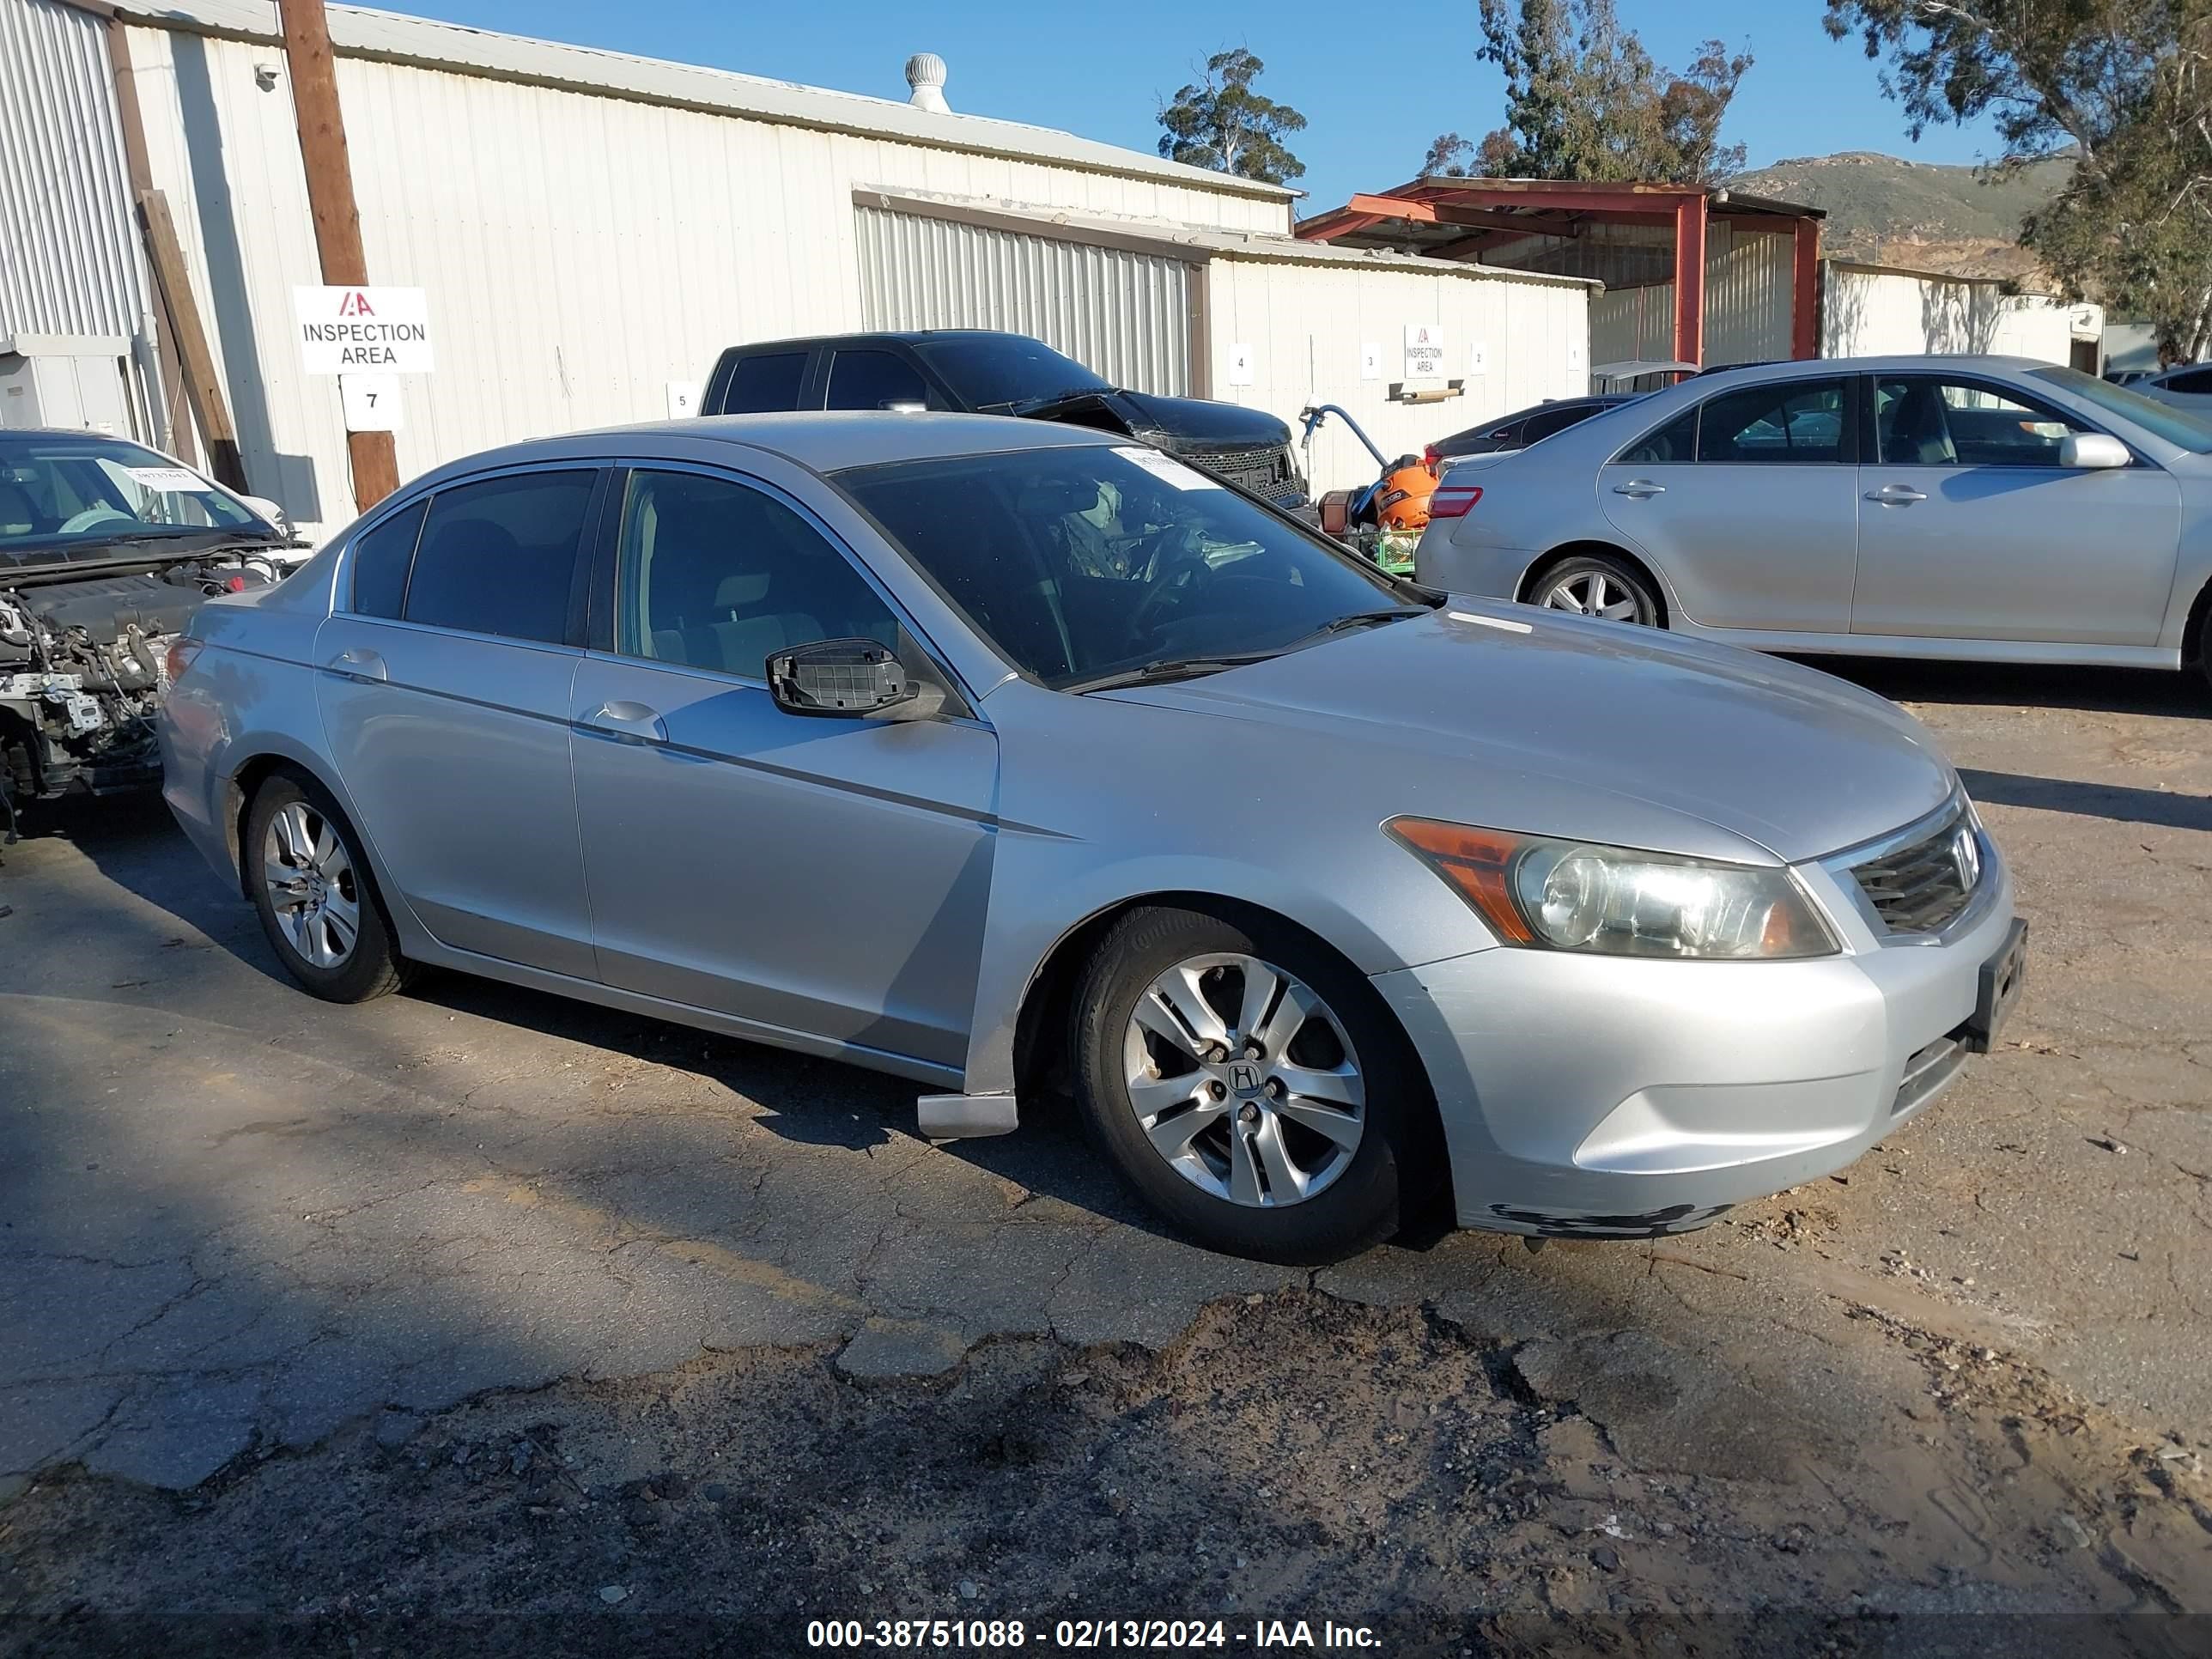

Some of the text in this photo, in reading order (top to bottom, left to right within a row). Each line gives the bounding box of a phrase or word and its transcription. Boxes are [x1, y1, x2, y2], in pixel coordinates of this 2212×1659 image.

[303, 323, 425, 342] INSPECTION
[341, 347, 398, 364] AREA
[1407, 347, 1443, 359] INSPECTION
[1238, 356, 1244, 369] 4
[1368, 356, 1374, 367] 3
[1416, 361, 1434, 372] AREA
[366, 393, 379, 409] 7
[679, 395, 686, 406] 5
